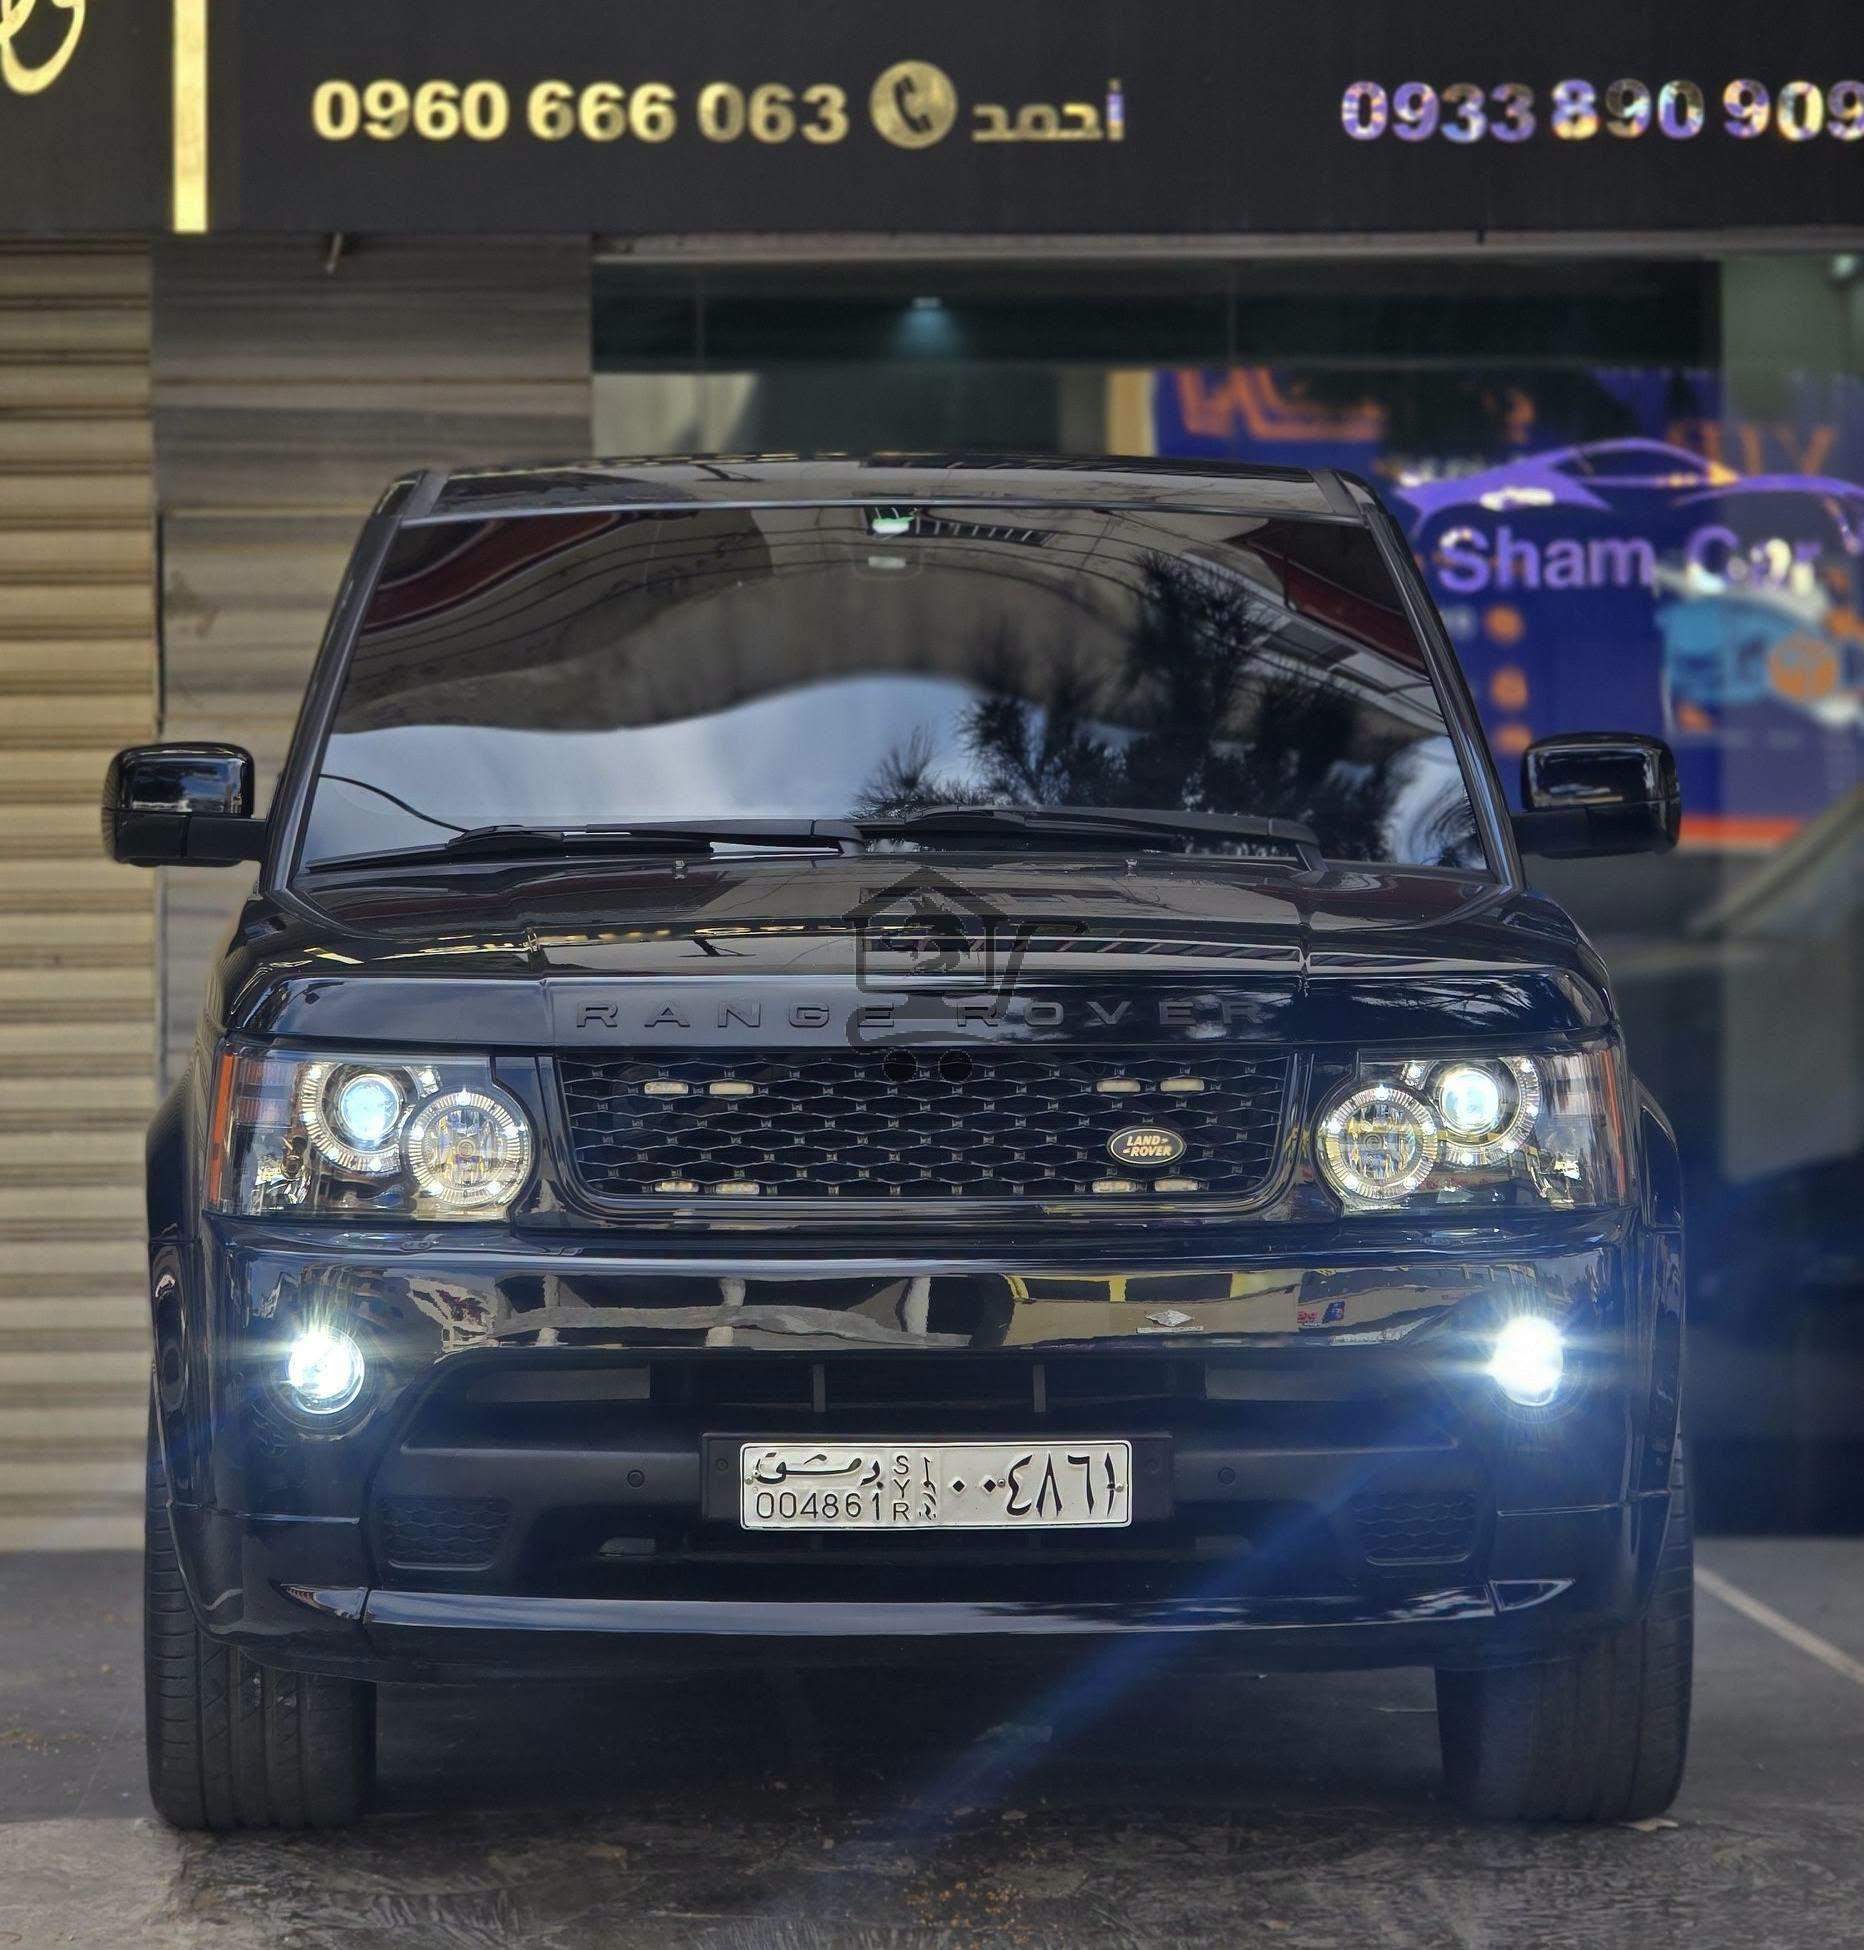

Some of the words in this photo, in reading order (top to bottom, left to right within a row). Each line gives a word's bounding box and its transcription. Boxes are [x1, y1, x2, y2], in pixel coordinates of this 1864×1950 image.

[312, 80, 510, 141] 0960
[526, 80, 677, 142] 666
[696, 82, 850, 144] 063
[971, 79, 1126, 142] أحمد
[1341, 80, 1537, 143] 0933
[1551, 79, 1706, 140] 890
[1722, 79, 1864, 141] 909
[1437, 527, 1657, 593] Sham
[576, 1001, 895, 1028] RANGE
[957, 1000, 1262, 1028] ROVER
[1126, 1135, 1161, 1147] LAND
[1130, 1145, 1173, 1157] ROVER
[756, 1492, 881, 1521] 004861
